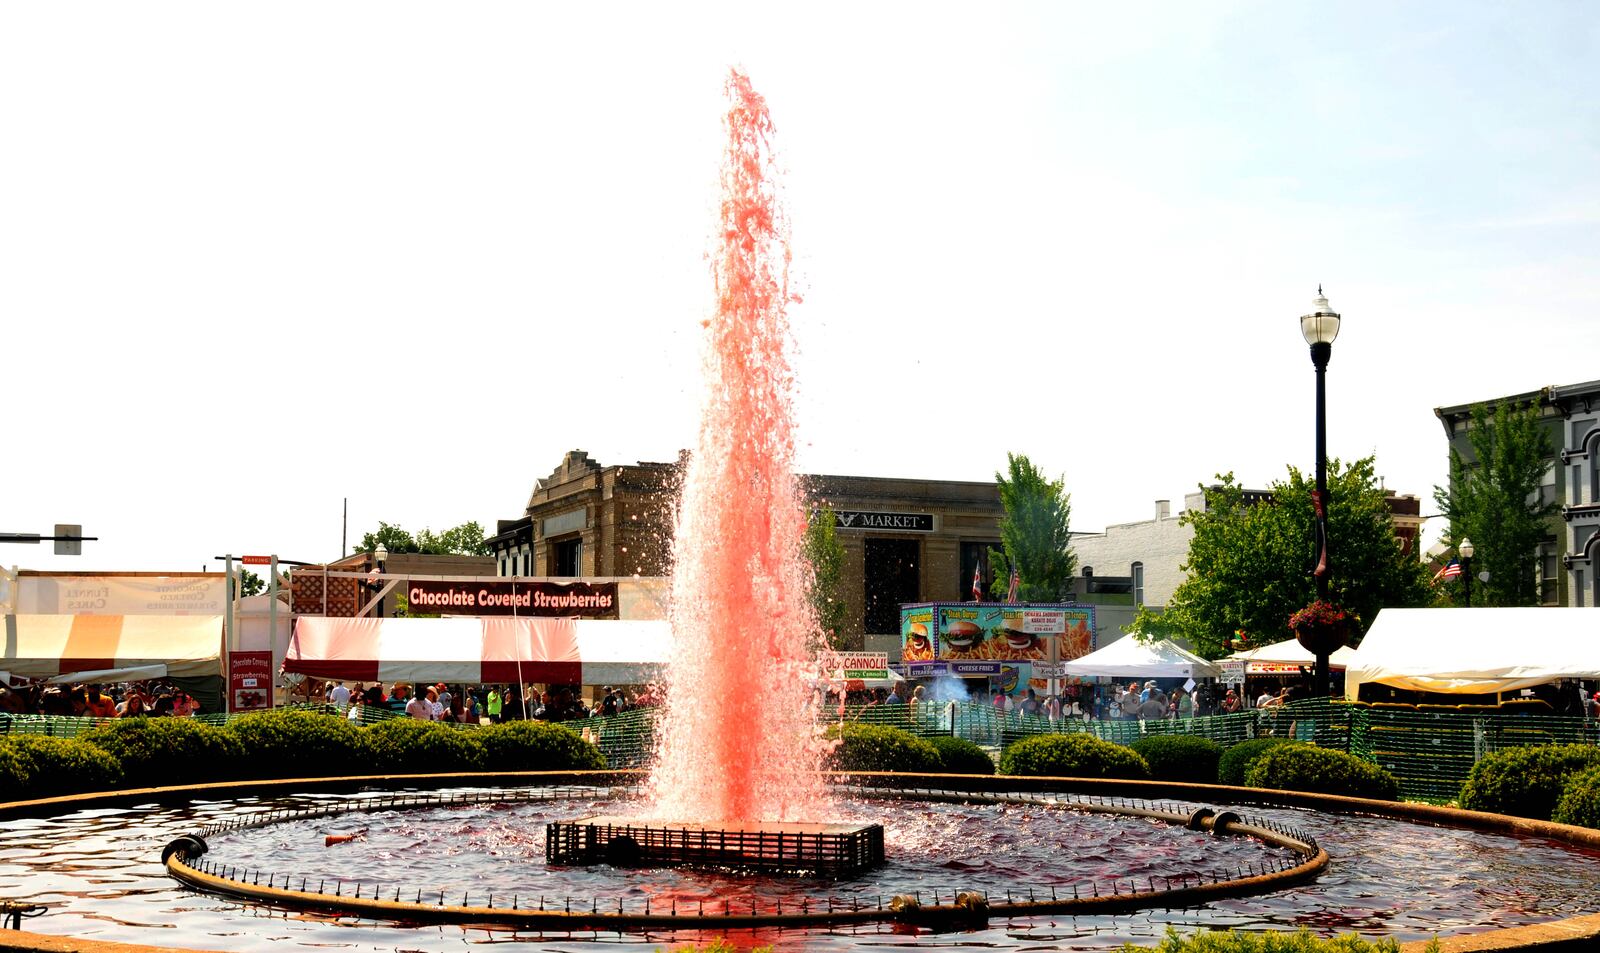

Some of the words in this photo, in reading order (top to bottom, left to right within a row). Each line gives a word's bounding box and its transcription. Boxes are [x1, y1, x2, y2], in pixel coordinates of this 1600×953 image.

[863, 514, 920, 528] MARKET
[410, 587, 475, 607] Chocolate
[477, 589, 531, 608] Covered
[533, 590, 613, 608] Strawberries
